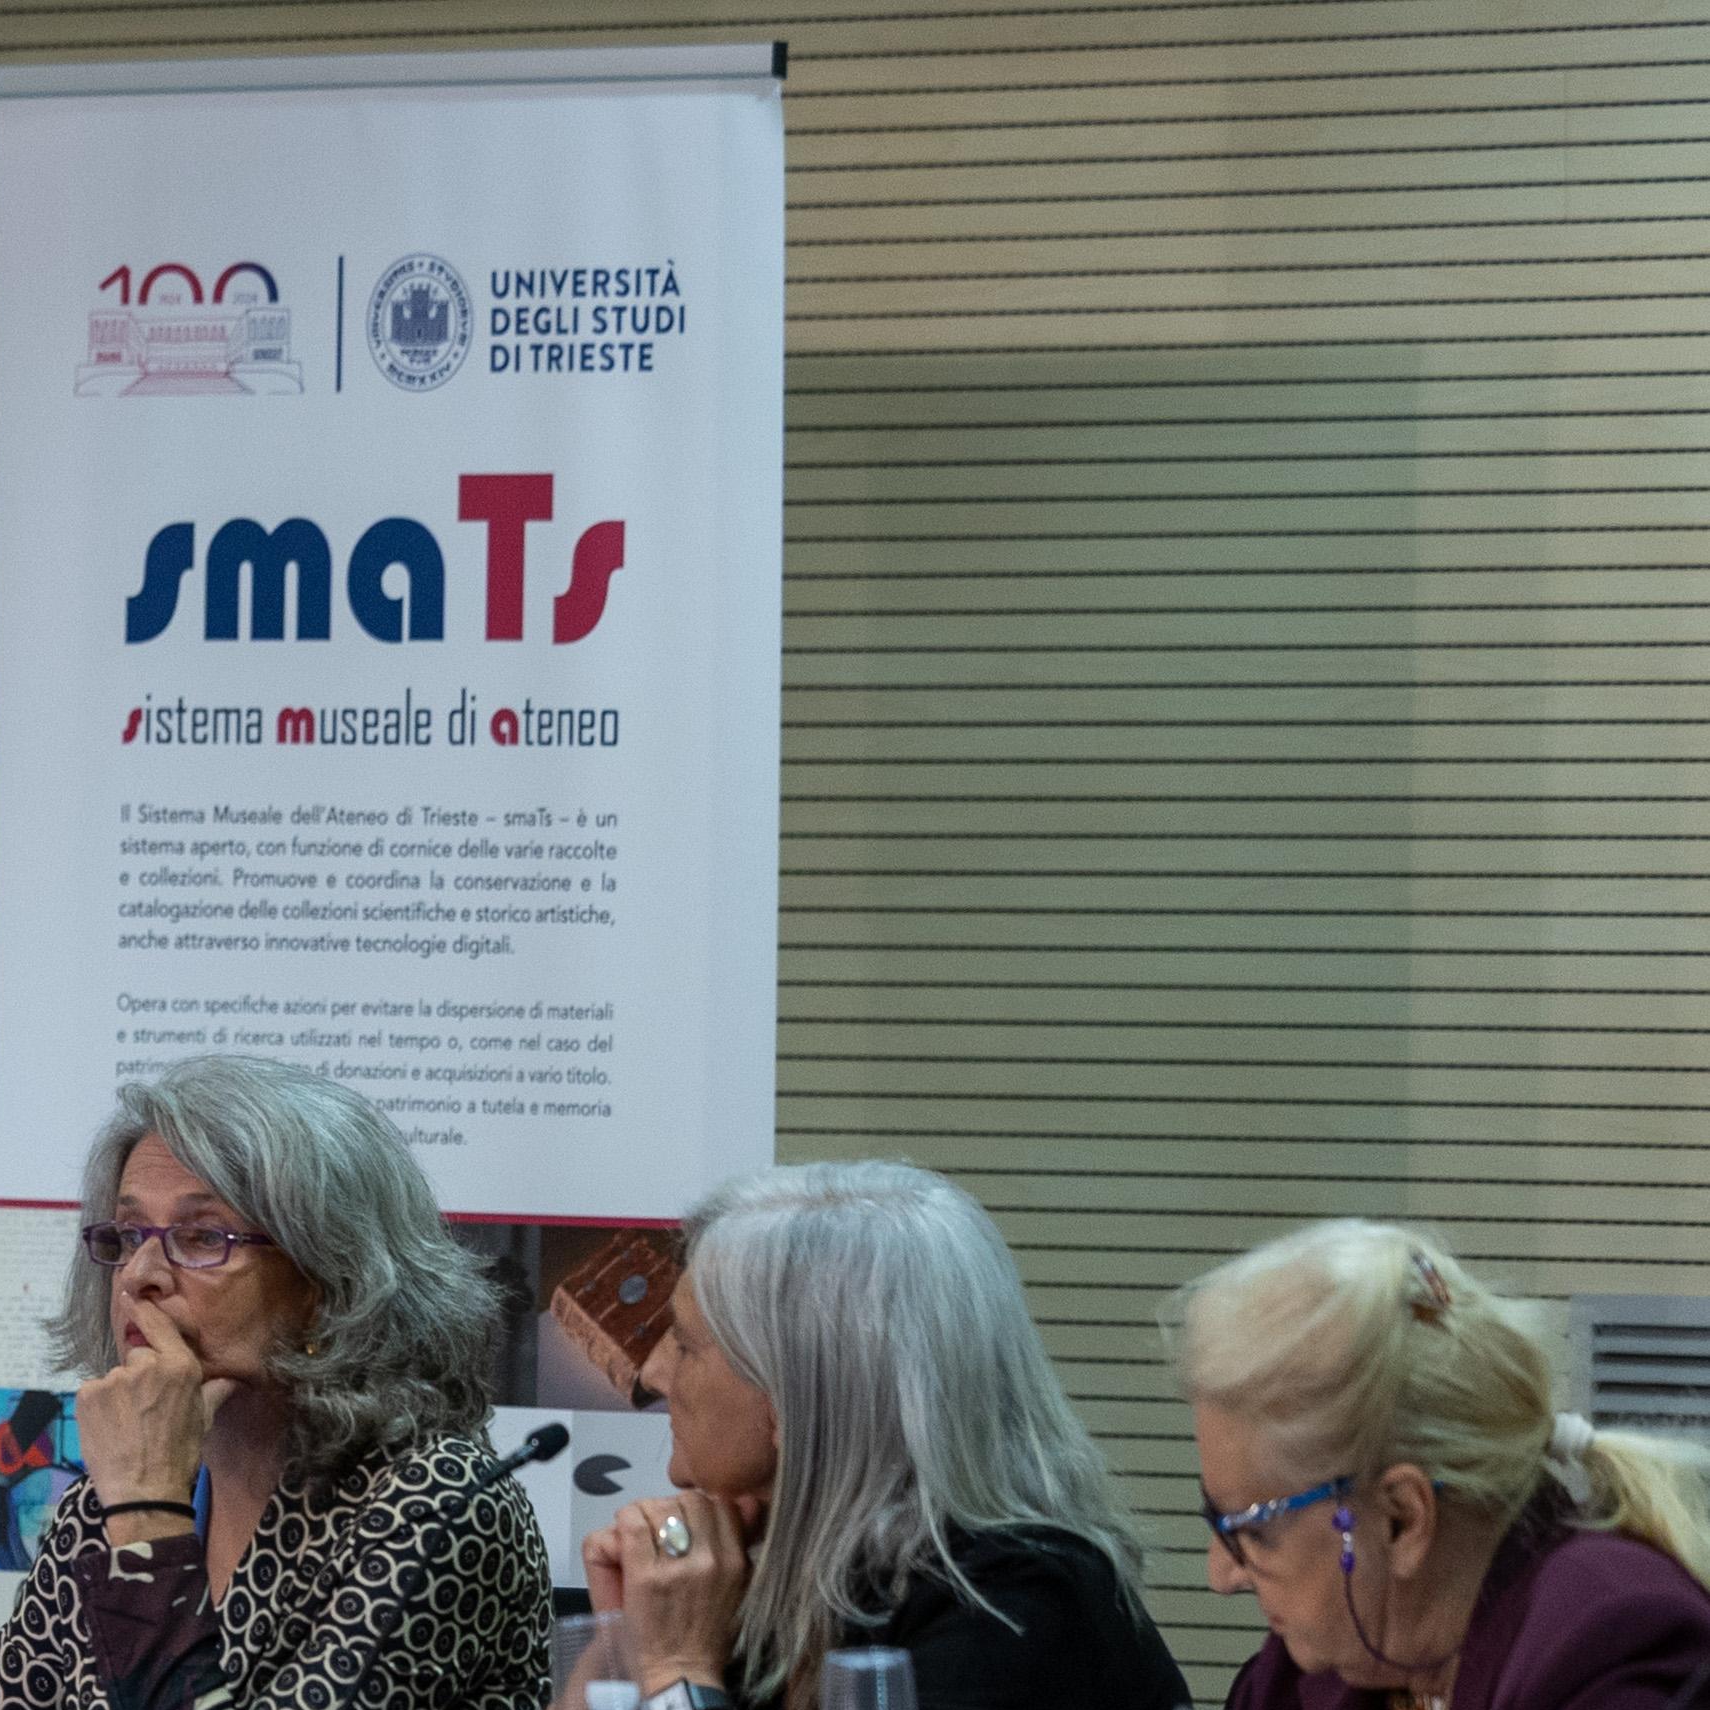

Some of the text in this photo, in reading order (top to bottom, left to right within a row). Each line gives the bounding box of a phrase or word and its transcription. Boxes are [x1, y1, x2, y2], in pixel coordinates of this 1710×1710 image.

[98, 261, 279, 305] 100
[490, 259, 680, 300] UNIVERSITÀ
[490, 304, 685, 336] DEGLI STUDI
[489, 342, 654, 373] DI TRIESTE
[124, 472, 625, 645] smaTs
[121, 687, 619, 747] sistema museale di ateneo
[120, 802, 618, 828] Il Sistema Museale dell'Ateneo di Trieste smaTs è un
[119, 835, 618, 861] sistema aperto, con funzione di cornice delle varie raccolte
[118, 865, 617, 893] e collezioni. Promuove e coordina la conservazione e la
[117, 897, 616, 927] catalogazione delle collezioni scientifiche e storico artistiche,
[117, 928, 515, 960] anche attraverso innovative tecnologie digitali.
[116, 991, 614, 1022] Opera con specifiche azioni per evitare la dispersione di materiali
[115, 1026, 614, 1053] e strumenti di ricerca utilizzati nel tempo o, come nel caso del
[313, 1061, 330, 1077] di
[334, 1061, 408, 1081] donazioni
[410, 1066, 422, 1081] e
[424, 1063, 513, 1086] acquisizioni
[515, 1068, 525, 1083] a
[527, 1065, 564, 1085] vario
[565, 1065, 612, 1086] titolo.
[466, 1099, 477, 1114] a
[481, 1096, 526, 1115] tutela
[528, 1101, 540, 1116] e
[542, 1099, 612, 1118] memoria
